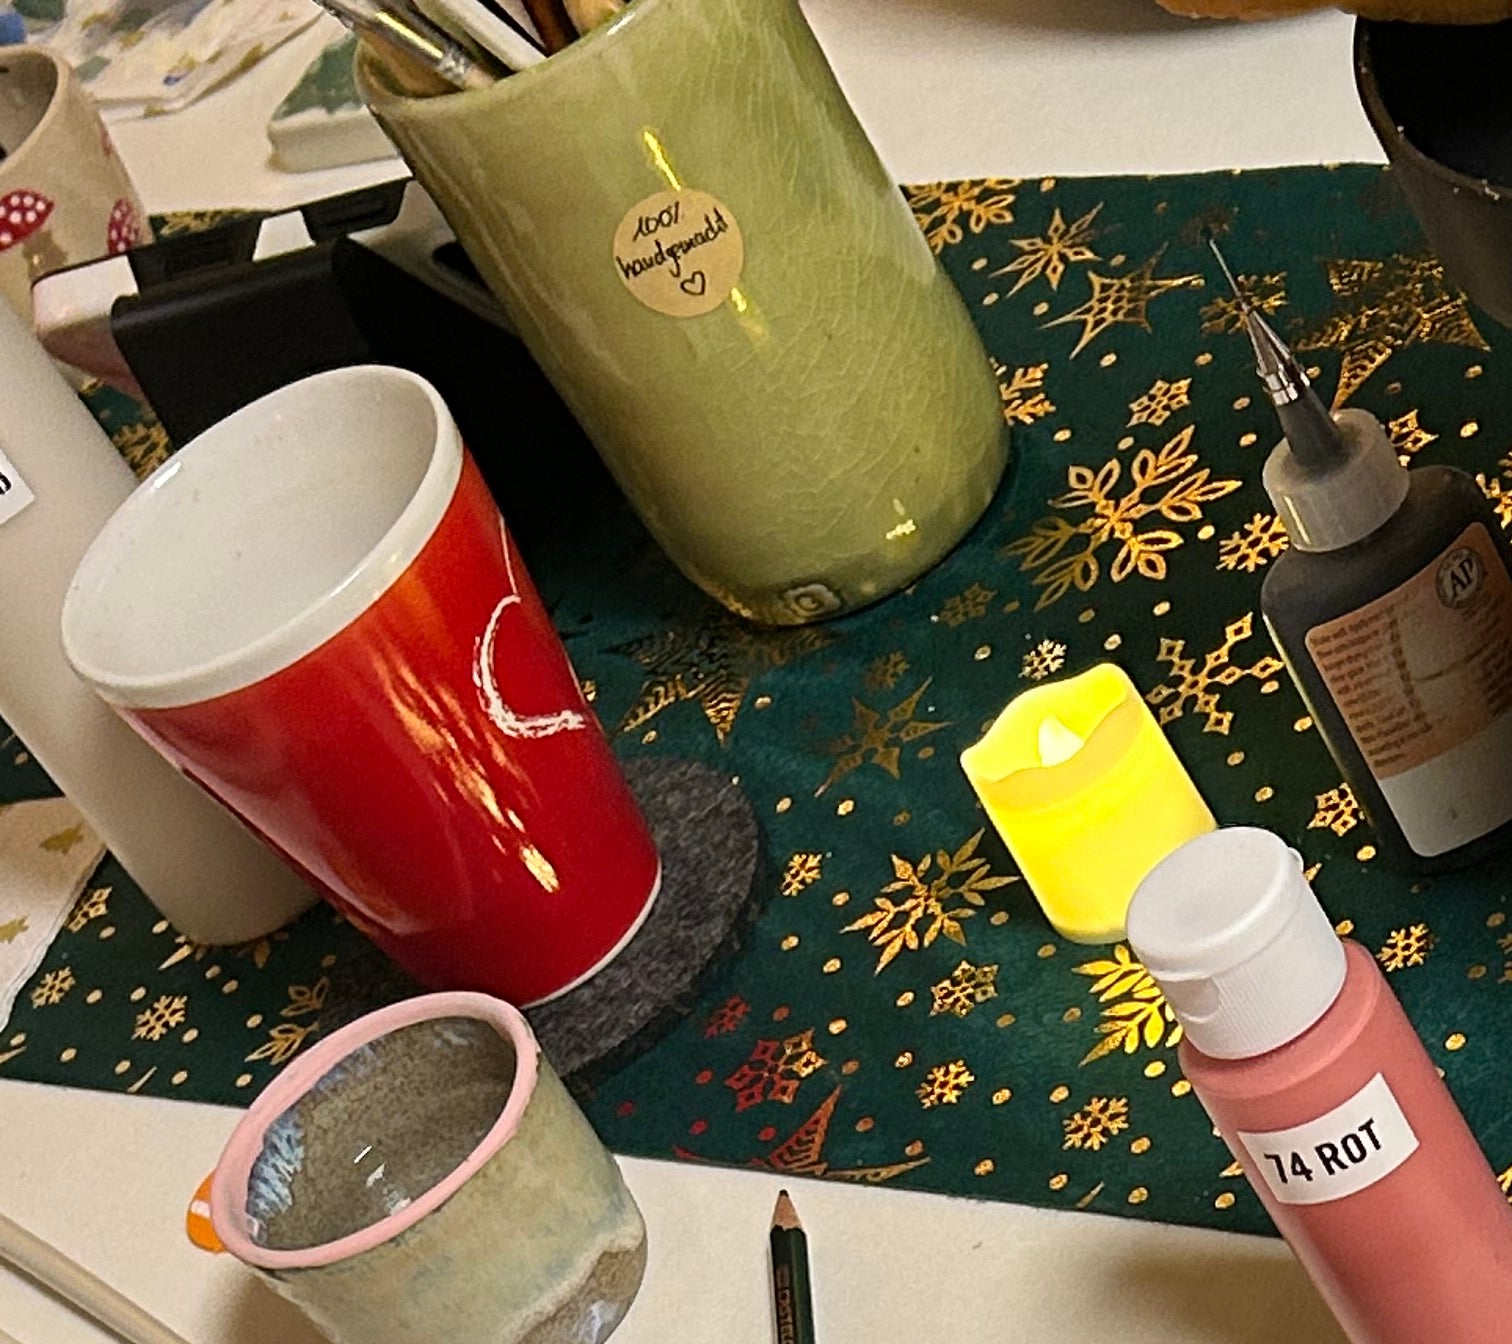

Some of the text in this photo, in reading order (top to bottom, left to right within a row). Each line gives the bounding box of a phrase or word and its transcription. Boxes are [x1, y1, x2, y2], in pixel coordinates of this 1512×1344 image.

[1449, 557, 1475, 598] AP
[1264, 1118, 1382, 1184] 74 ROT
